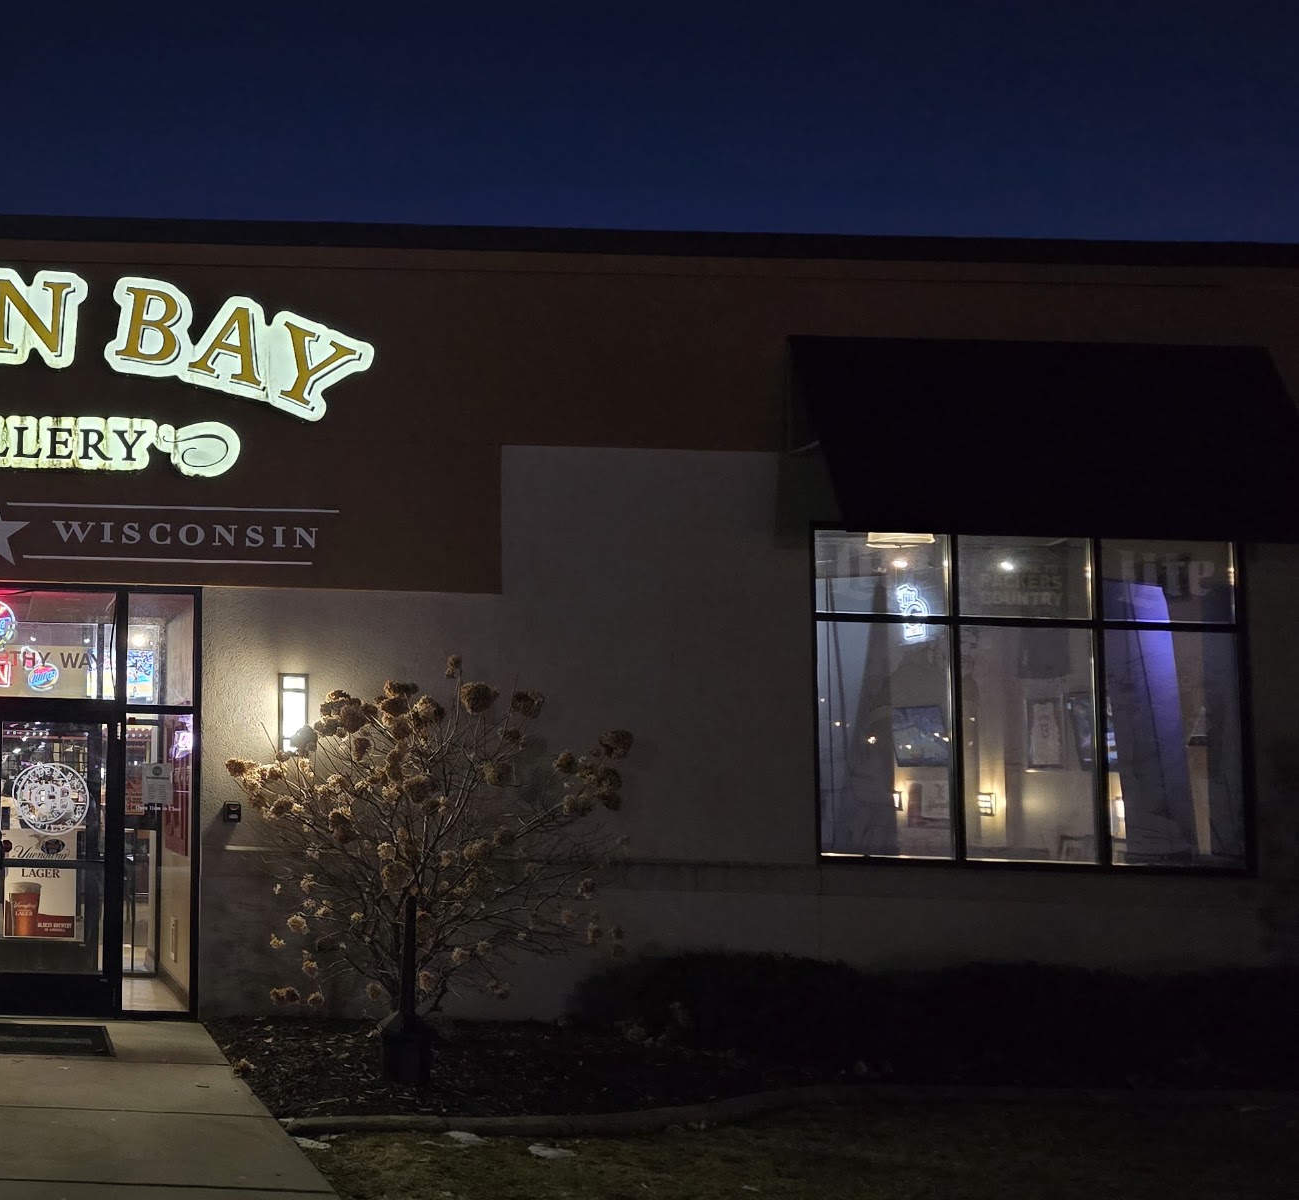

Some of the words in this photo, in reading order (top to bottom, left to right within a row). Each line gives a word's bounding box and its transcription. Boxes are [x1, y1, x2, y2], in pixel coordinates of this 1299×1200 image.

[114, 285, 364, 410] BAY
[52, 519, 320, 551] WISCONSIN
[21, 868, 60, 878] LAGER
